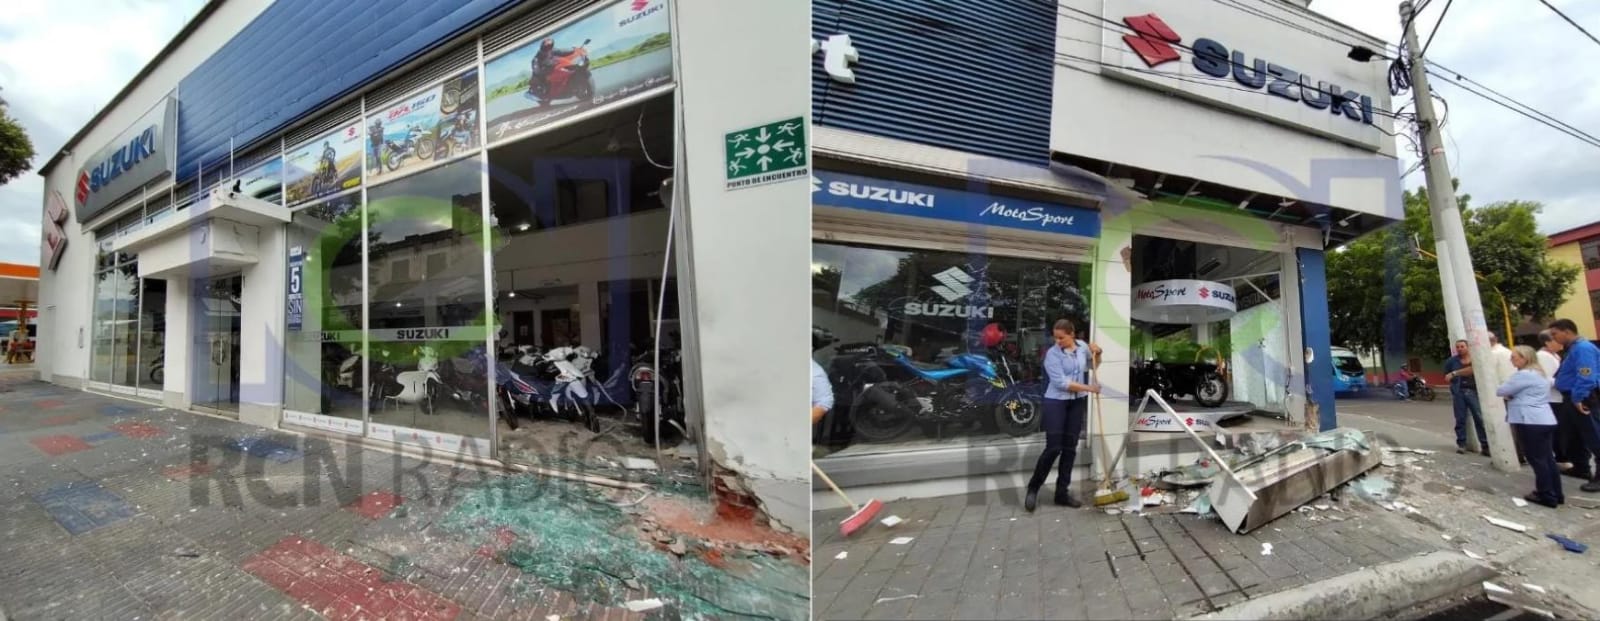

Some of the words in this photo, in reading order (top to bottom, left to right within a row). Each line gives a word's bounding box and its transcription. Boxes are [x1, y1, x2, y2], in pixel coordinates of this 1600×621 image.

[618, 3, 664, 28] SUZUKI
[1191, 37, 1374, 125] SUZUKI
[89, 125, 156, 193] SUZUKI
[727, 179, 751, 188] PUNTO
[752, 176, 761, 184] DE
[763, 169, 808, 182] ENCUENTRO
[828, 180, 935, 209] SUZUKI
[290, 266, 300, 294] 5
[904, 301, 995, 320] SUZUKI
[397, 328, 449, 340] SUZUKI
